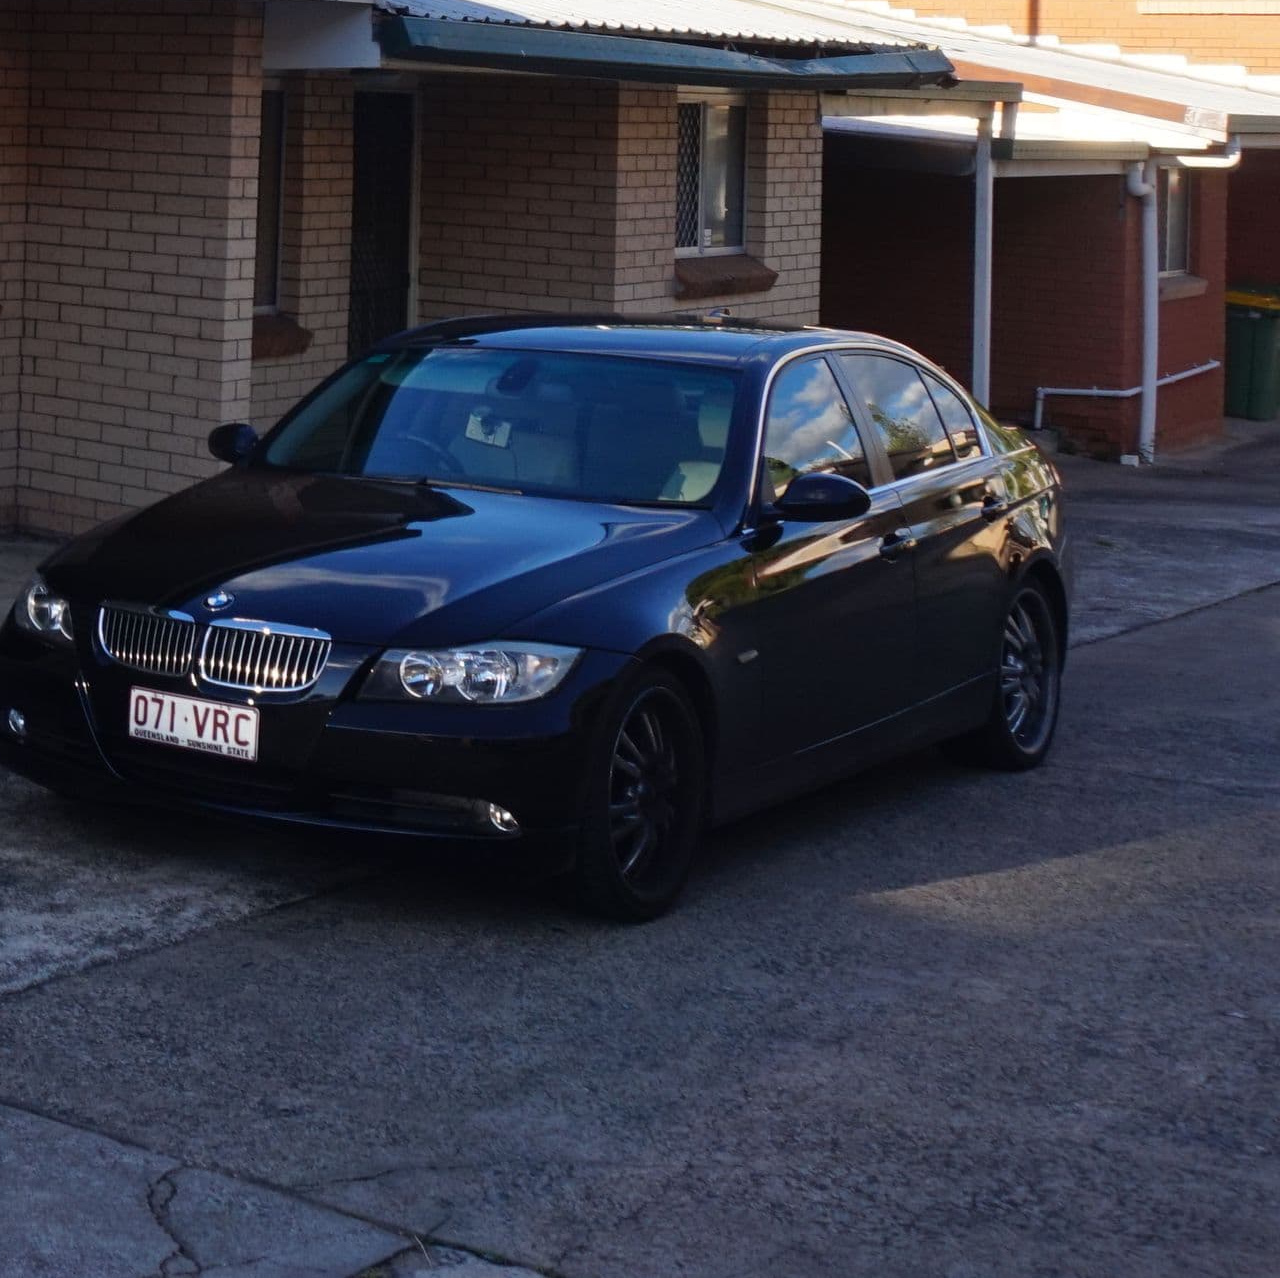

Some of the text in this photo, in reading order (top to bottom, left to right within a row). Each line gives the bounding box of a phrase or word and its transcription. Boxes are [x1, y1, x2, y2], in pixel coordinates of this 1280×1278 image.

[134, 728, 180, 744] QUEENSLAND
[187, 739, 223, 753] SUNSHINE
[227, 746, 249, 758] STATE
